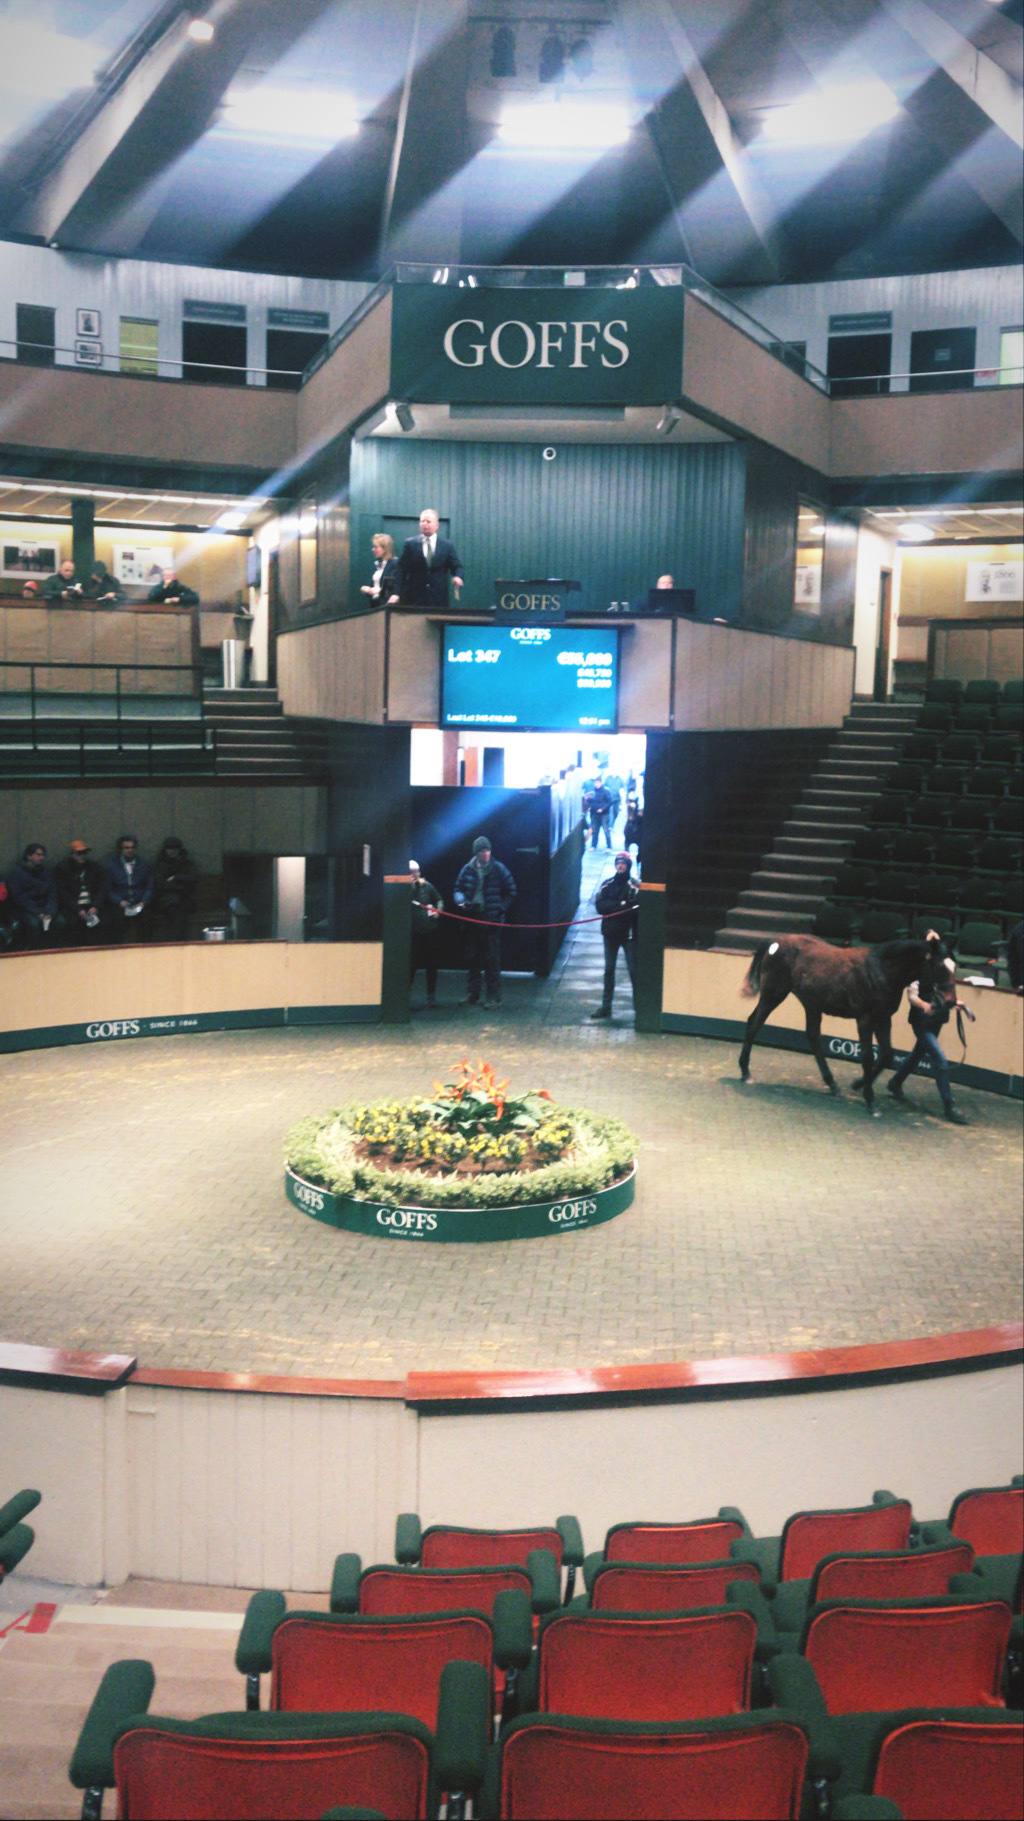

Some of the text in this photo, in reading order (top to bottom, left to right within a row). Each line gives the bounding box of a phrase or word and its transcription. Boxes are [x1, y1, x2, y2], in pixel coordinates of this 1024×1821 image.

[443, 319, 630, 368] GOFFS
[500, 593, 561, 611] GOFFS
[510, 628, 551, 640] GOFFS
[448, 649, 501, 663] Lot 347
[86, 1019, 198, 1038] GOFFS SINCE 1866
[294, 1182, 324, 1210] GOFFS
[376, 1208, 438, 1230] GOFFS
[548, 1198, 597, 1222] GOFFS
